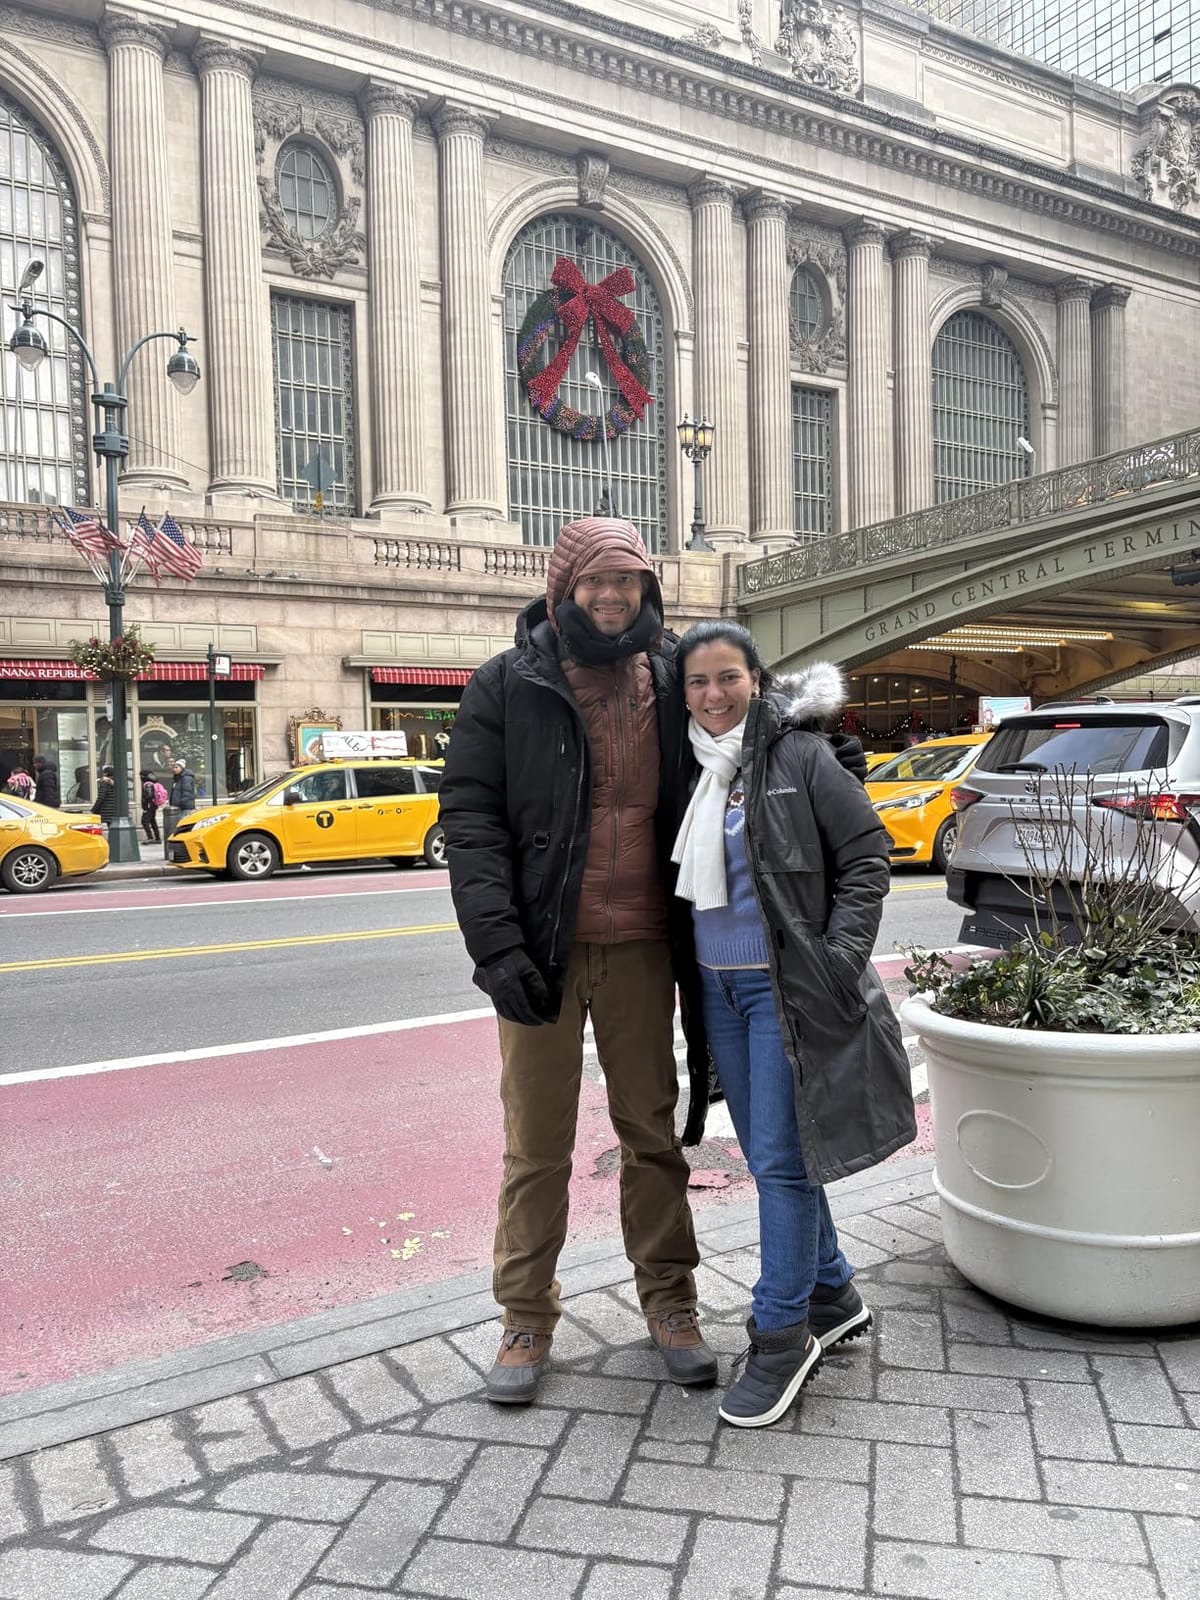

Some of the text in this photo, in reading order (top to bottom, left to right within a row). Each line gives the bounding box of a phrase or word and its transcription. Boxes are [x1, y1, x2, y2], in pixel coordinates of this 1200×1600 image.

[865, 602, 936, 641] GRAND
[951, 557, 1065, 607] CENTRAL
[0, 668, 94, 679] NANA REPUBLIC
[318, 812, 331, 827] T
